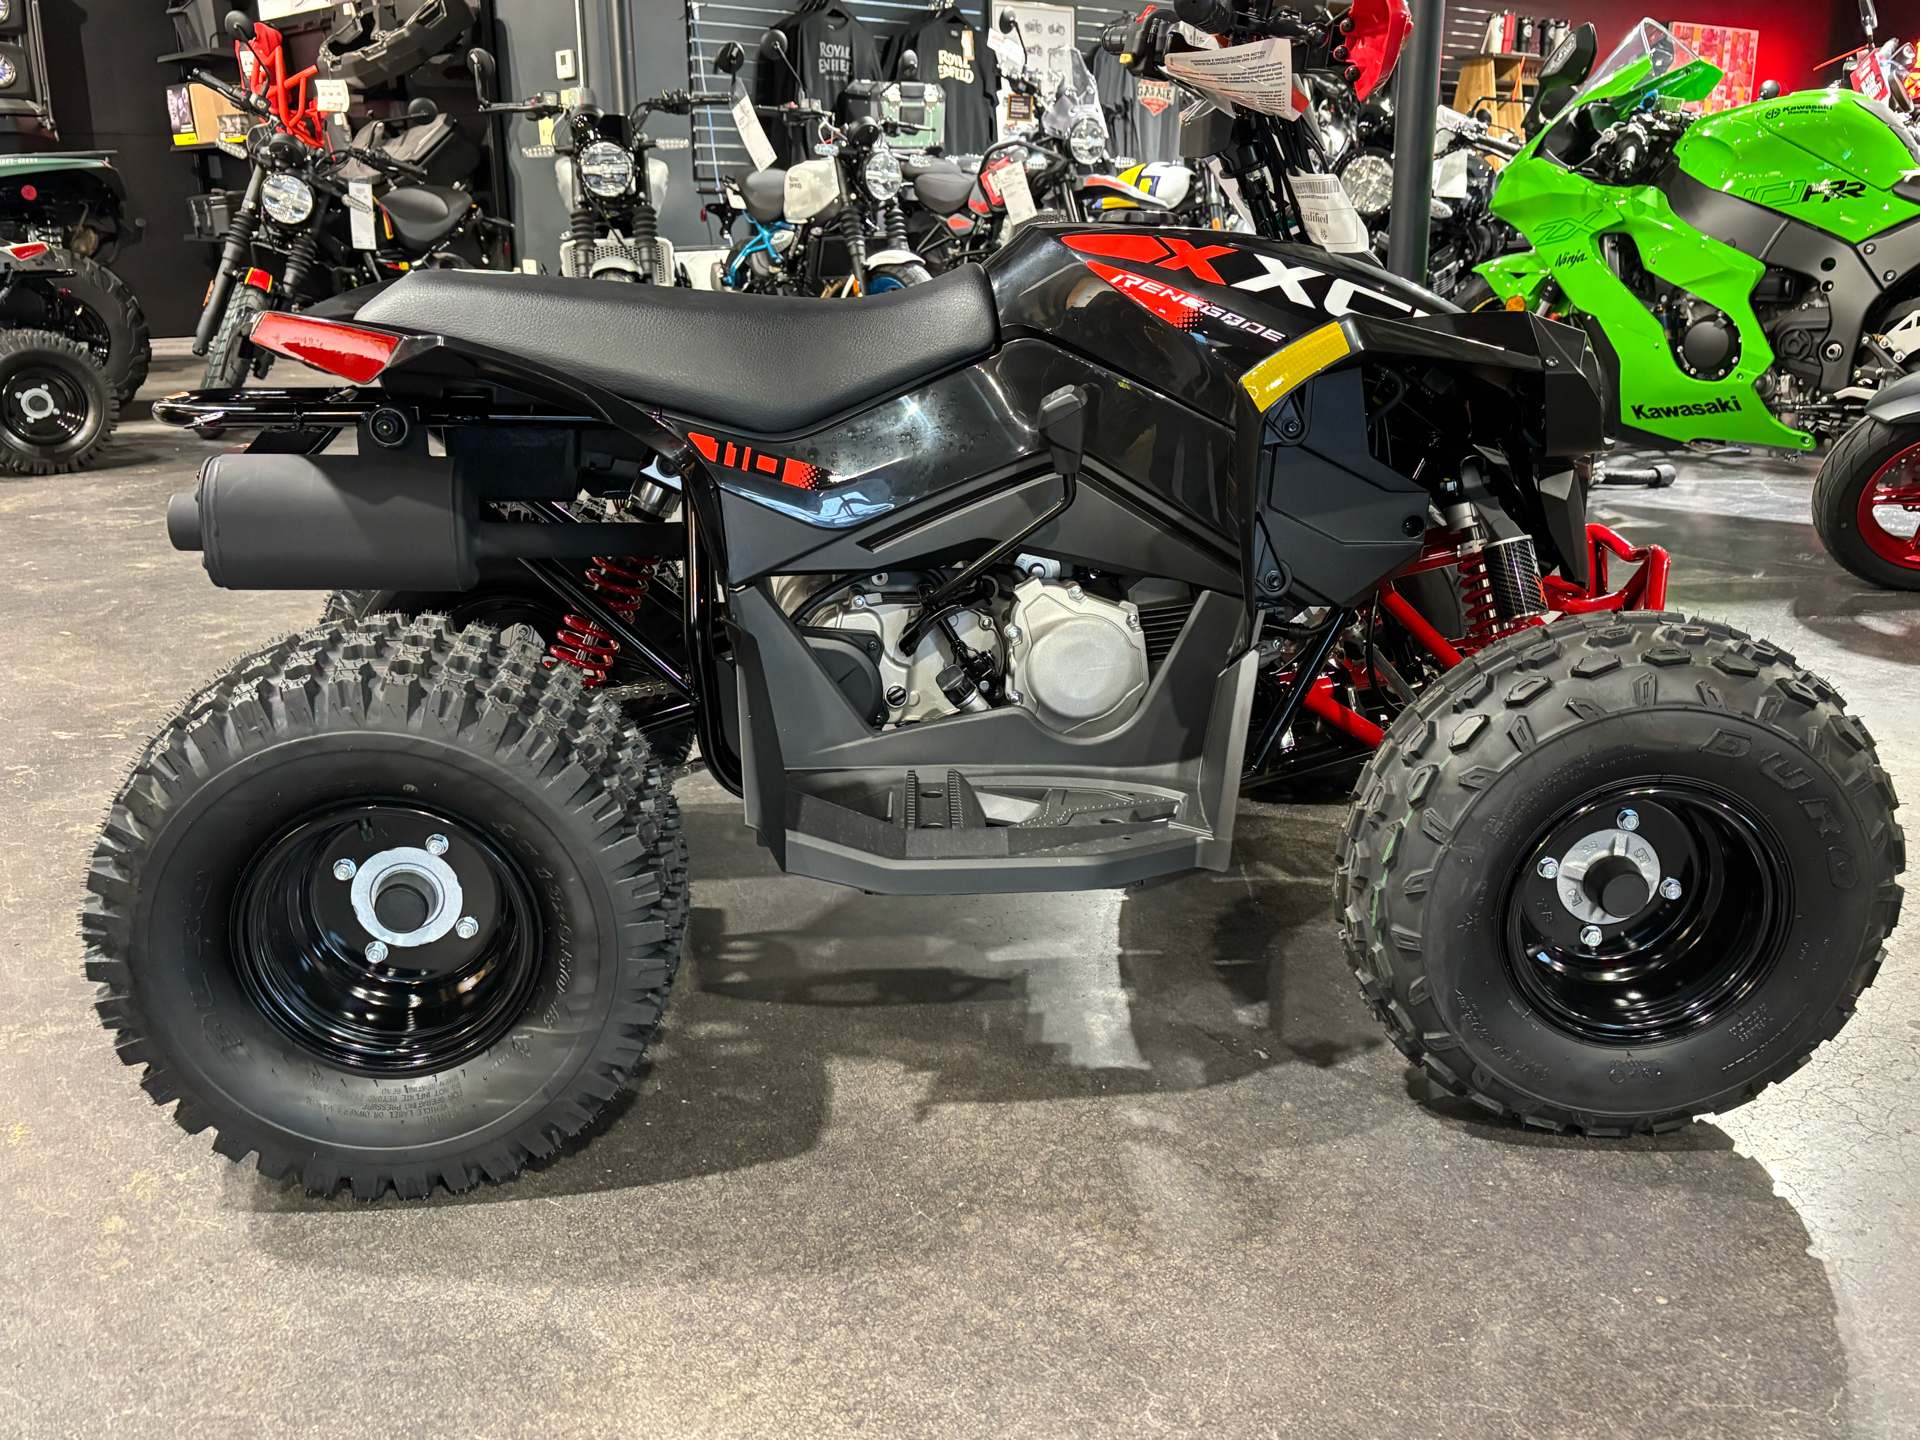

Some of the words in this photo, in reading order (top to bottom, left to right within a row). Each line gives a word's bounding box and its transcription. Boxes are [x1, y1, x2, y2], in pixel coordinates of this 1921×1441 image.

[819, 41, 851, 59] ROYAL
[938, 50, 970, 68] ROYAL
[938, 64, 975, 84] ENFIELD
[1783, 104, 1833, 112] Kawasaki
[1533, 208, 1603, 247] ZX
[1555, 249, 1588, 269] Ninja
[1110, 274, 1286, 342] RENEGADE
[1631, 396, 1742, 420] Kawasaki
[1699, 727, 1859, 889] DURO
